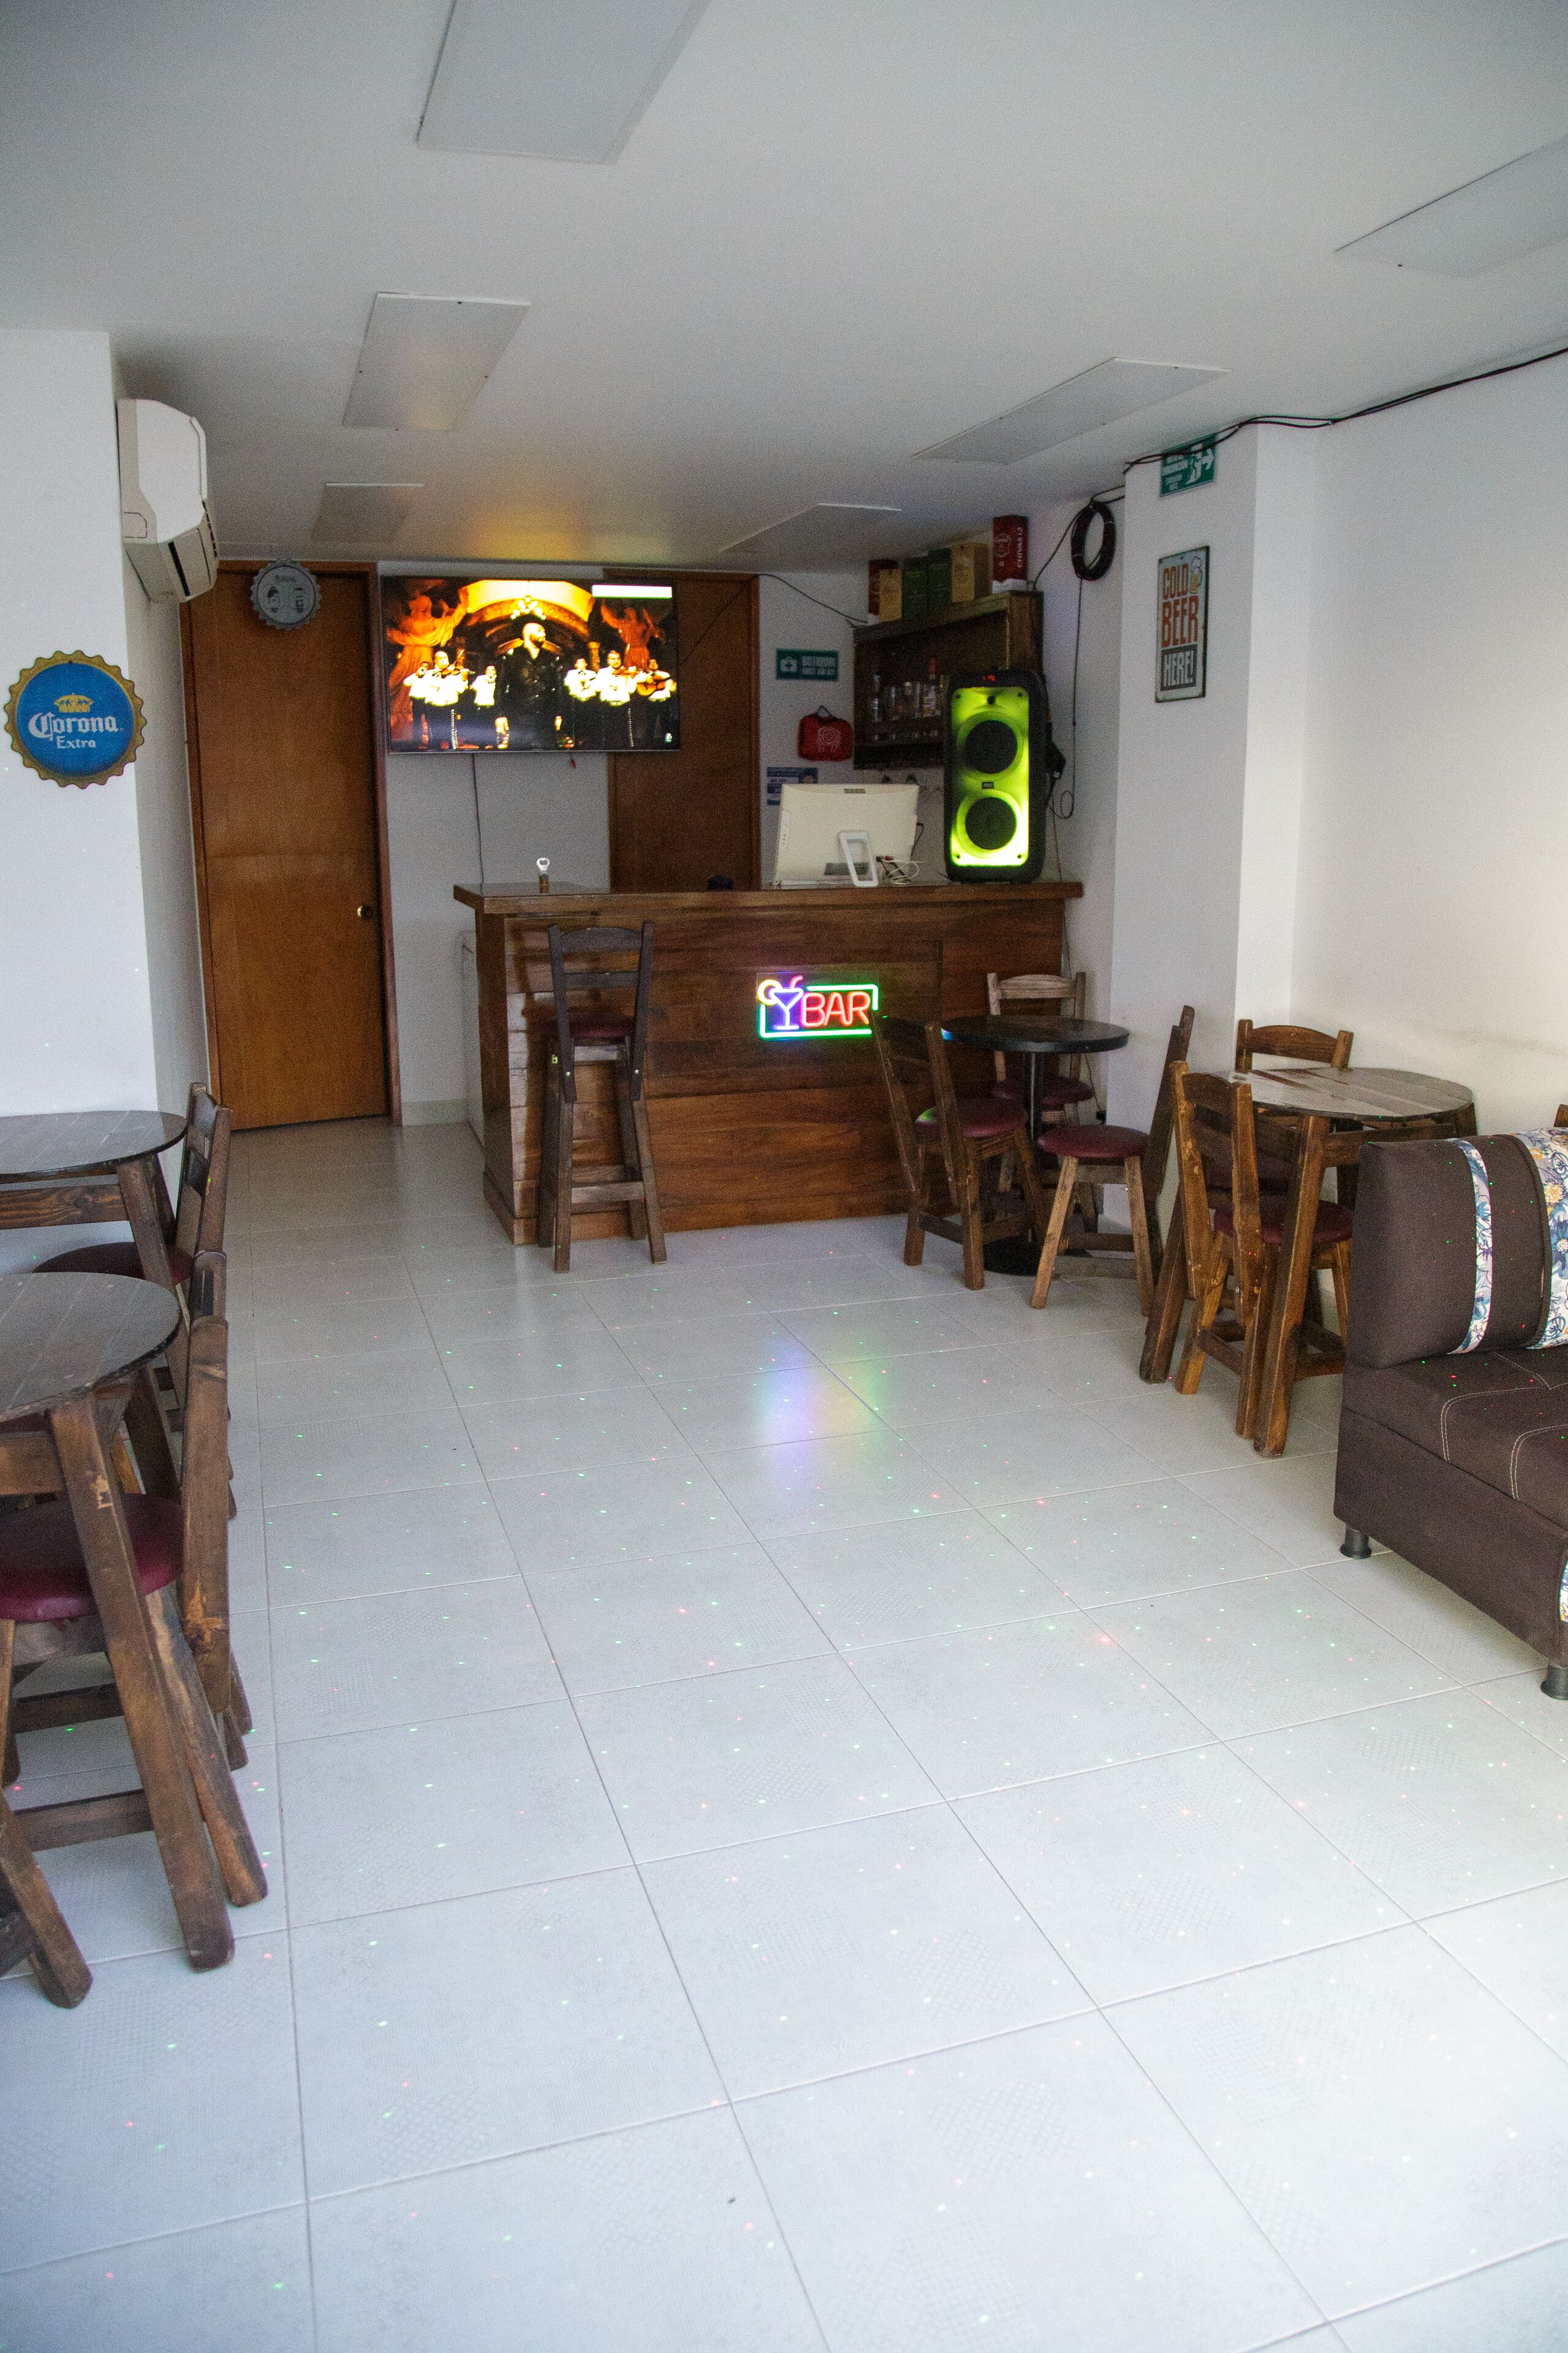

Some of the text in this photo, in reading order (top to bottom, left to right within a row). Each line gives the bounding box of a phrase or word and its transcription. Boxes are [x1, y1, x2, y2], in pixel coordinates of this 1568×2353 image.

[1162, 563, 1189, 599] COLD
[1161, 595, 1199, 648] BEER
[28, 713, 118, 740] Corona
[56, 736, 96, 748] Extra
[802, 991, 871, 1028] BAR
